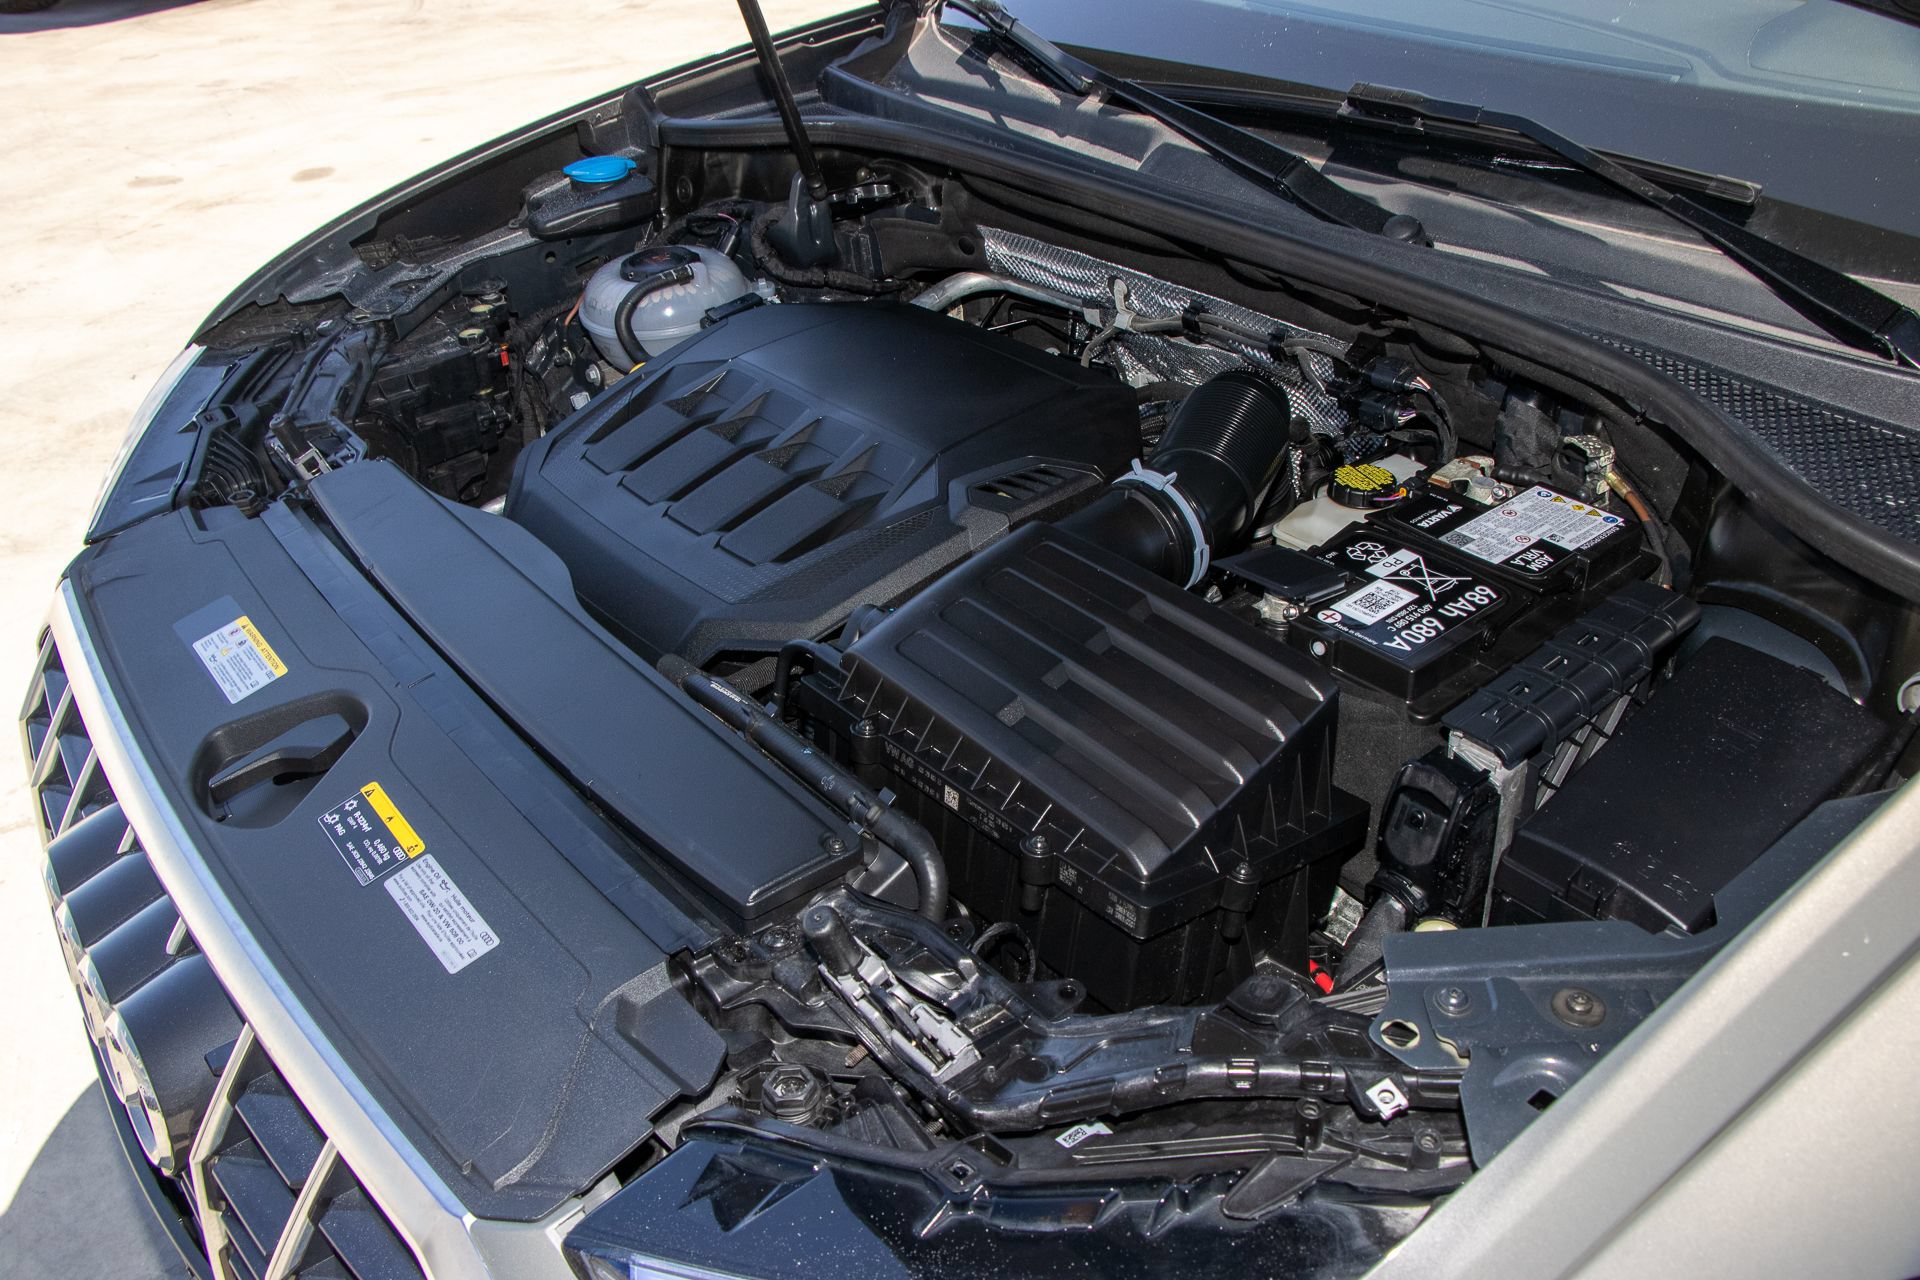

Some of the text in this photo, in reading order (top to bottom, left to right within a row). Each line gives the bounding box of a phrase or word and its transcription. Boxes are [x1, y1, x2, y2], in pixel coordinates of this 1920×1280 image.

[1417, 511, 1452, 527] VARTA
[1382, 557, 1404, 568] Pb
[1510, 549, 1544, 566] VRLA
[1526, 554, 1553, 571] AGM
[1438, 586, 1497, 617] 68Ah
[1405, 612, 1421, 621] 915
[1334, 623, 1349, 632] Made
[1353, 630, 1379, 645] Germany
[261, 648, 279, 670] ATTENTION
[334, 823, 345, 836] PAG
[353, 811, 372, 832] R-1234yf
[346, 842, 355, 851] SAE
[374, 839, 390, 861] 0,460 kg
[422, 858, 435, 873] Engine
[419, 889, 429, 900] SAE
[427, 899, 440, 914] 0W-20
[443, 918, 450, 928] VW
[449, 928, 459, 938] 508
[451, 894, 461, 906] Huile
[460, 906, 475, 922] moteur
